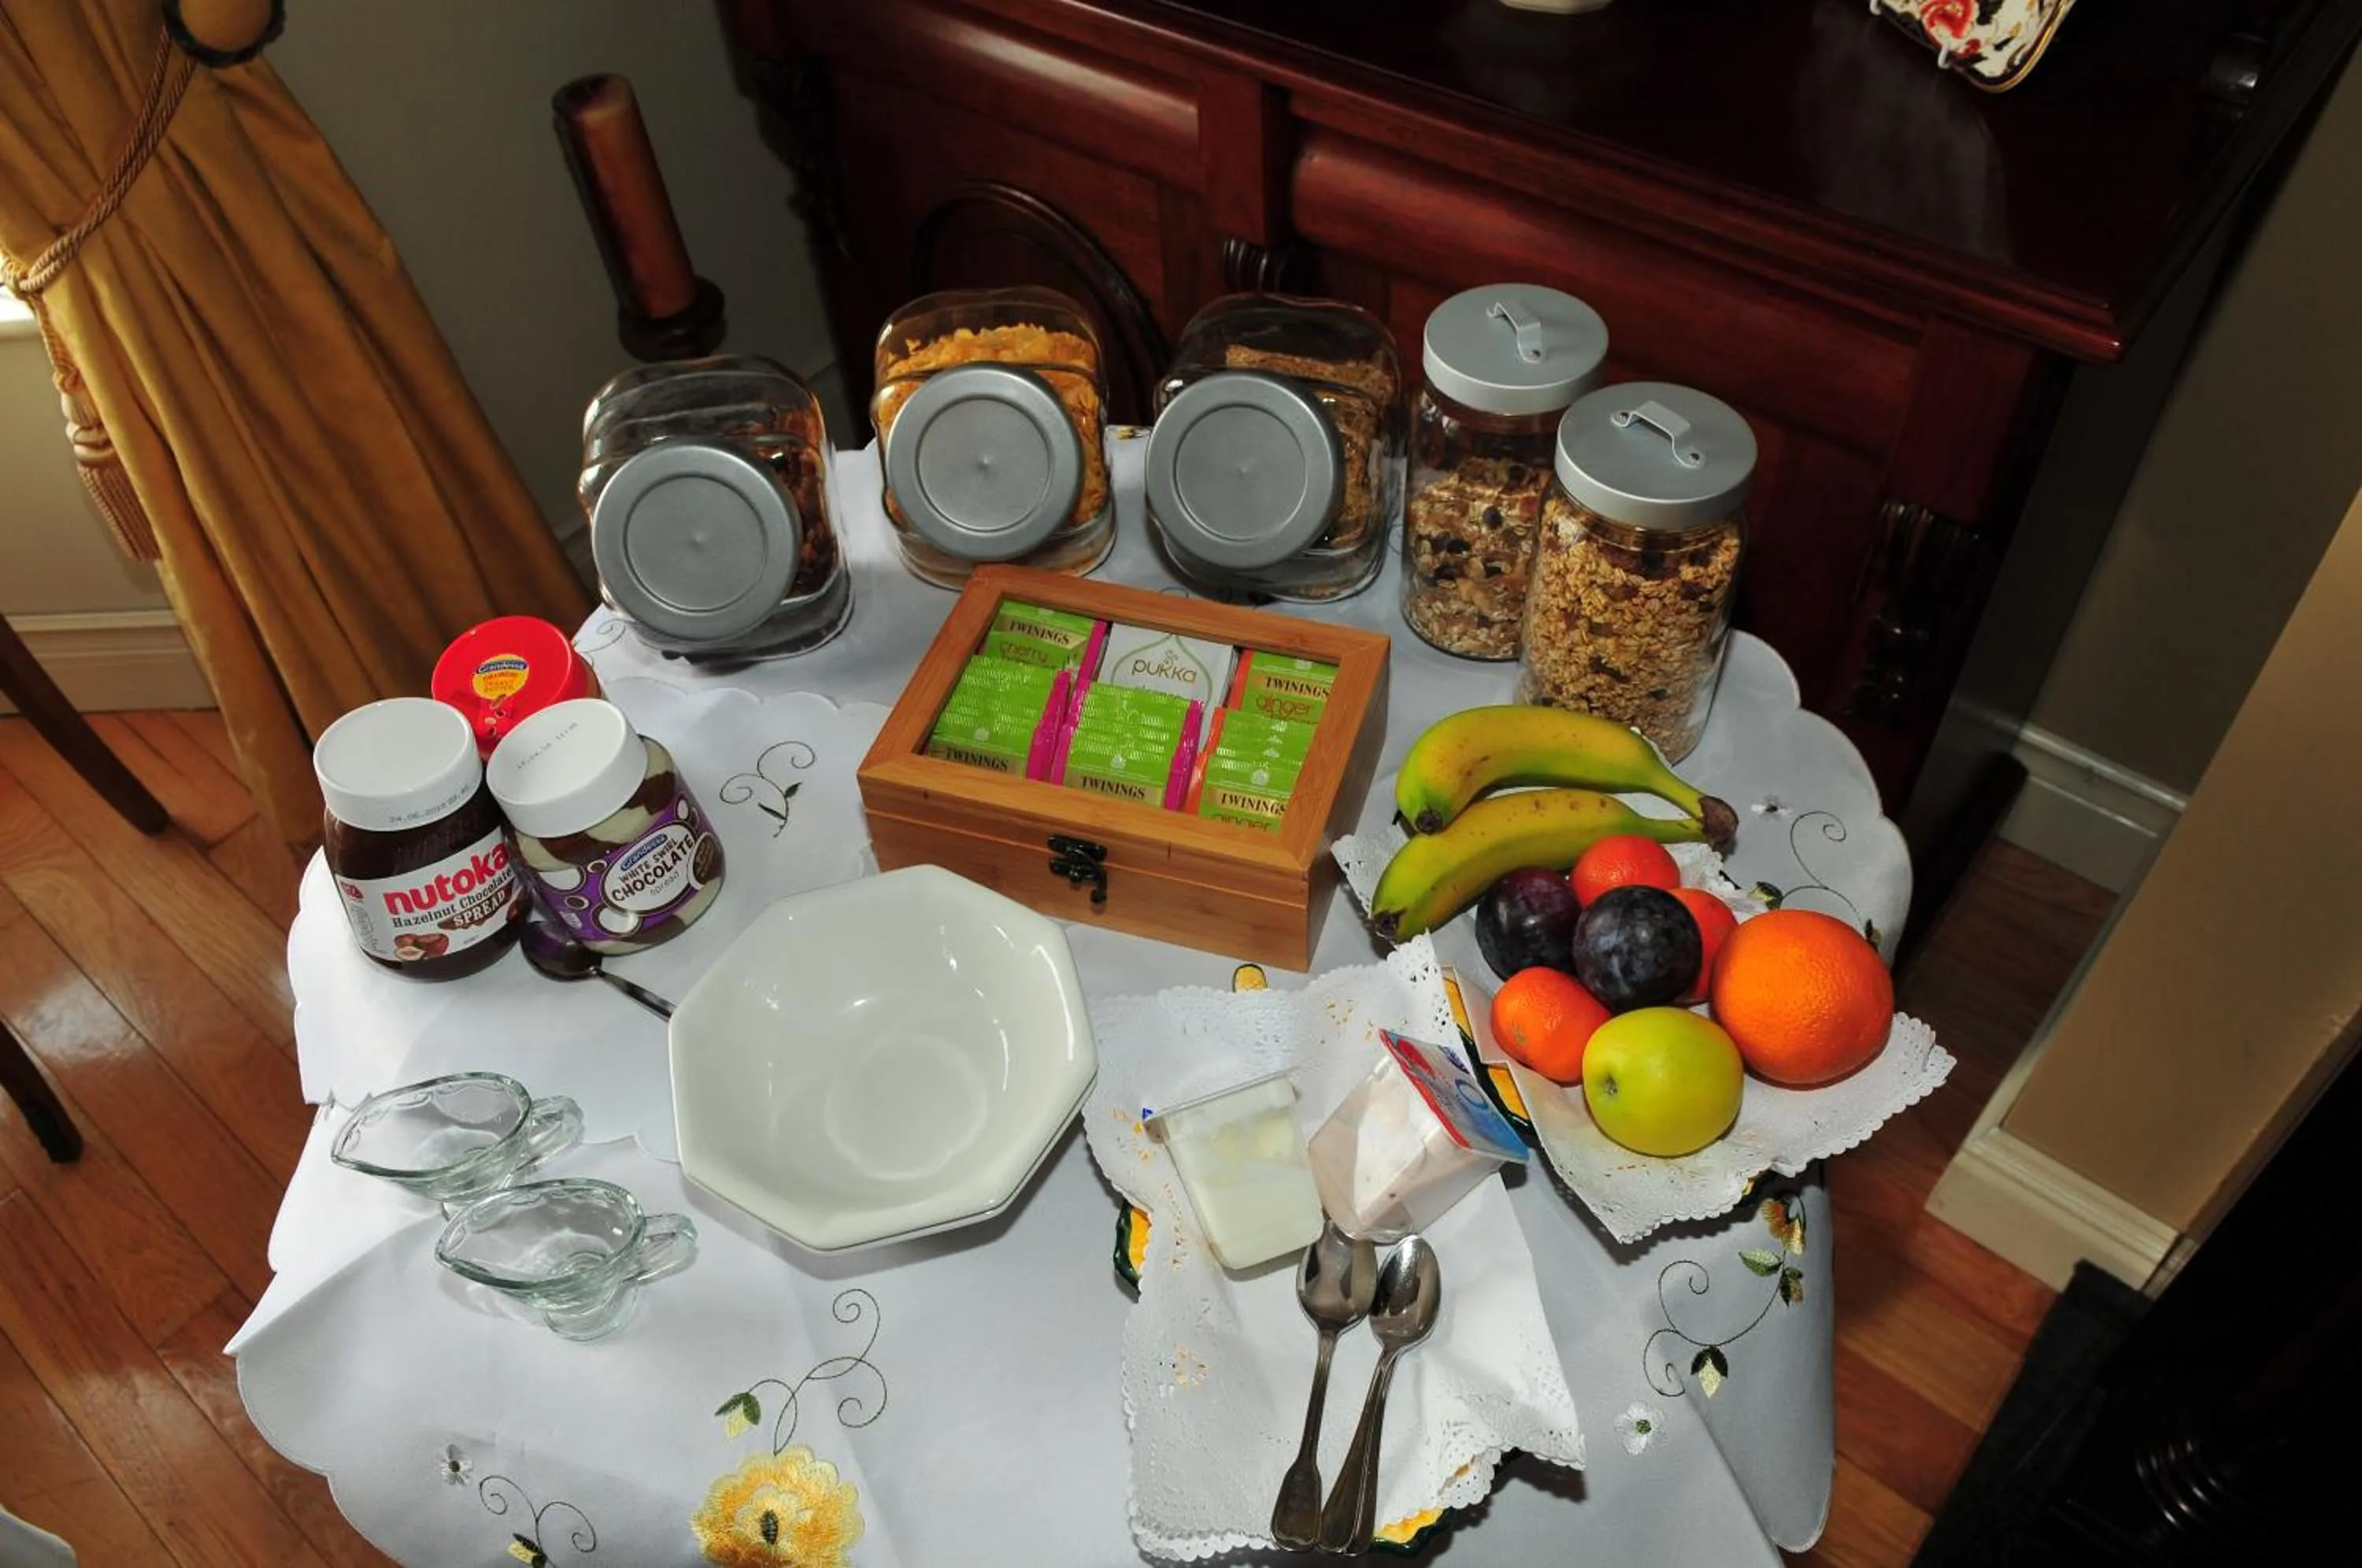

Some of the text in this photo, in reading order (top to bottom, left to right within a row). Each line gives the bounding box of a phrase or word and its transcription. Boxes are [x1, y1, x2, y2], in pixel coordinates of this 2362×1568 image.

[1010, 620, 1069, 645] TWININGS
[1132, 658, 1198, 683] pukka
[1266, 676, 1329, 698] TWININGS
[946, 747, 1009, 772] TWININGS
[1081, 775, 1146, 800] TWININGS
[1221, 793, 1285, 815] TWININGS
[612, 834, 694, 901] CHOCOLATE
[619, 860, 650, 883] WHITE
[653, 838, 678, 864] SWIRL
[382, 843, 510, 915] nutoka
[650, 871, 679, 897] spread
[392, 904, 456, 928] Hazelnut
[460, 867, 513, 911] Chocolate
[453, 889, 505, 927] SPREAD
